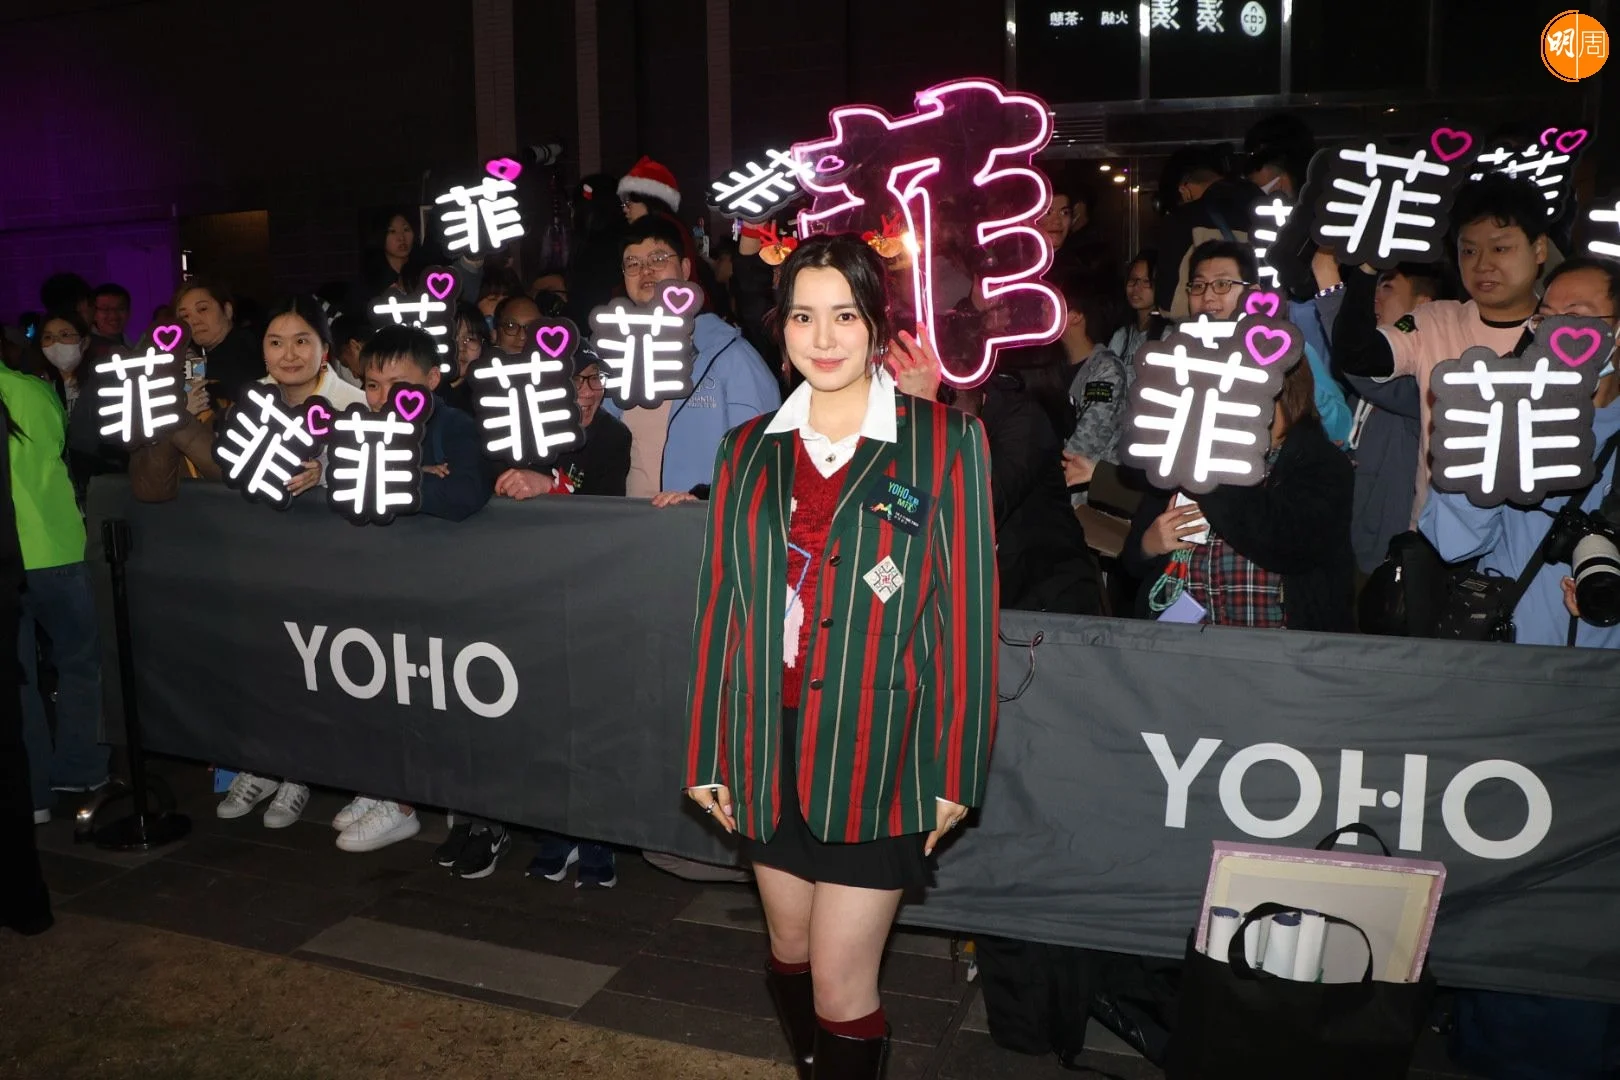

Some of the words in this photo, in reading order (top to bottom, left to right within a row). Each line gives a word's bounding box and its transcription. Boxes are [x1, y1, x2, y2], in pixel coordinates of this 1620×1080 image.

[435, 176, 525, 254] 菲
[1321, 144, 1449, 257] 菲
[95, 347, 178, 442] 菲
[474, 352, 575, 460] 菲
[597, 305, 685, 401] 菲
[217, 389, 314, 501] 菲
[333, 411, 415, 515] 菲
[1129, 344, 1269, 482] 菲
[1443, 358, 1582, 493] 菲
[284, 621, 519, 718] YOHO
[1141, 732, 1553, 859] YOHO
